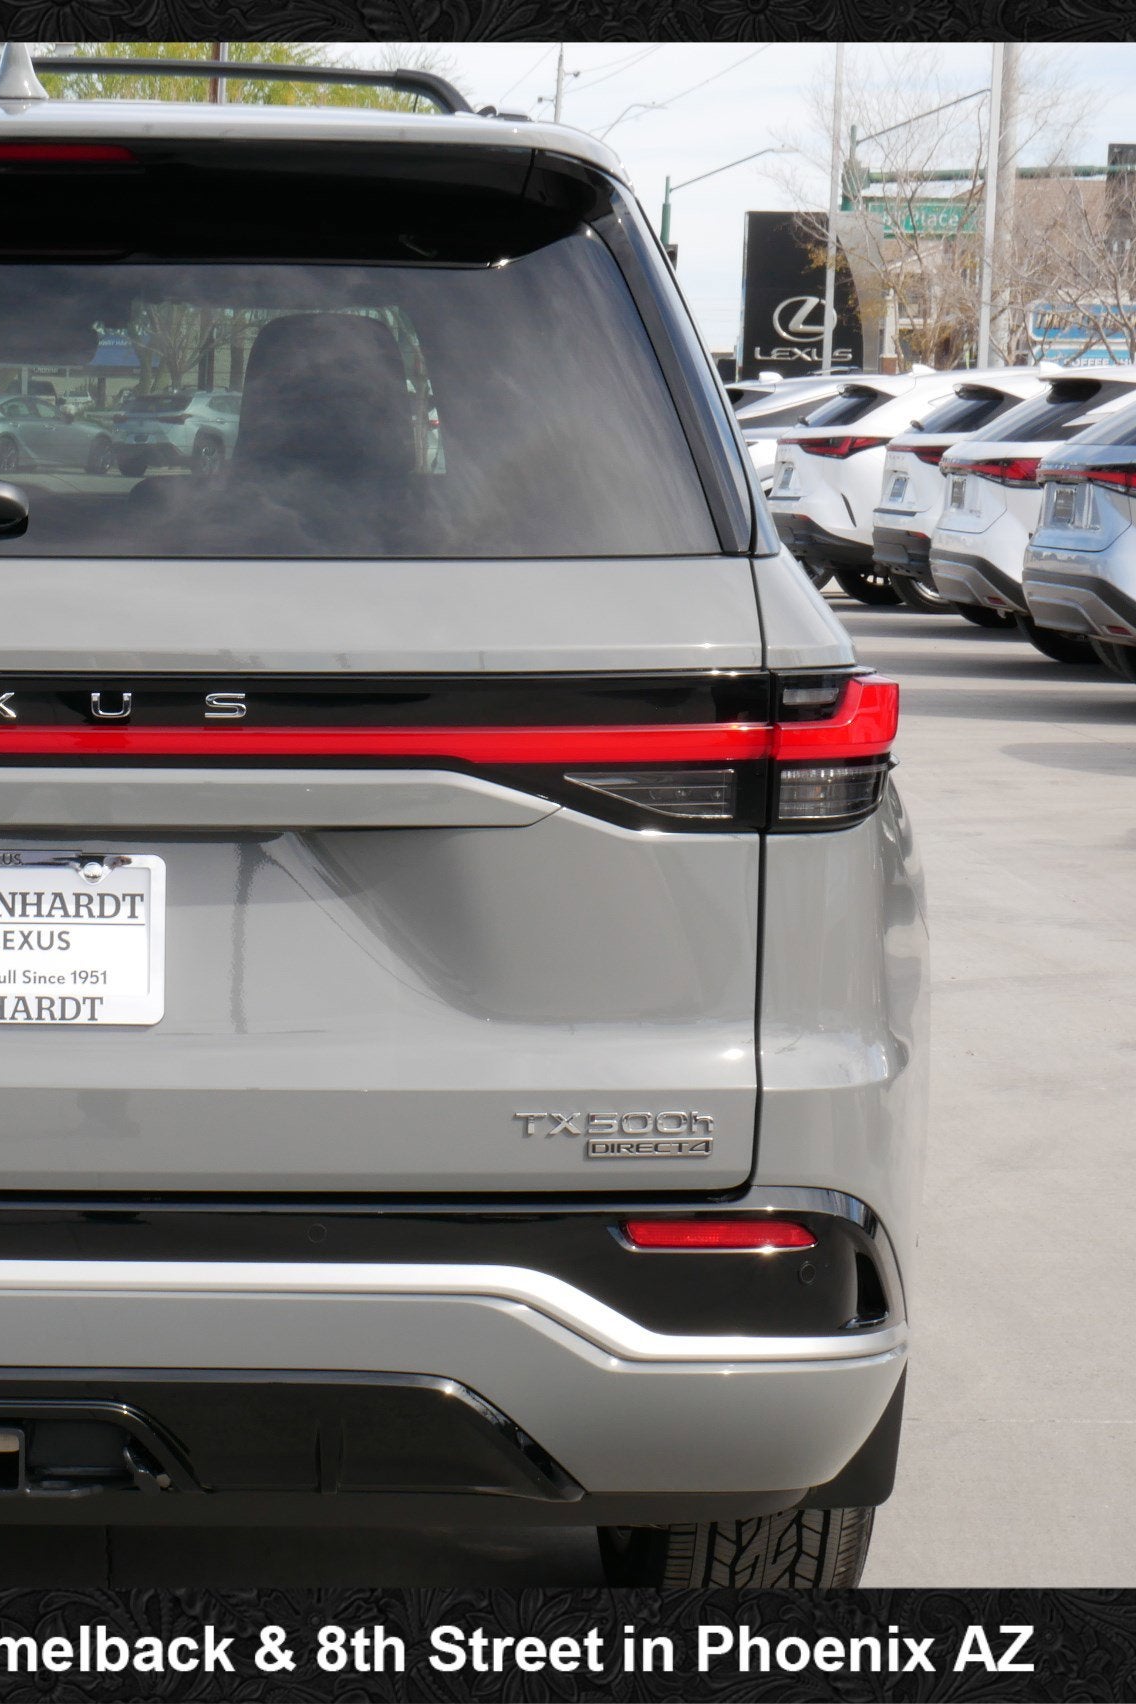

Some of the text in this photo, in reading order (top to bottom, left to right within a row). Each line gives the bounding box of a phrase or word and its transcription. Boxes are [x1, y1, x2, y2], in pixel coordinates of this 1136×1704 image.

[754, 347, 853, 362] LEXUS
[22, 970, 65, 985] Since
[71, 970, 108, 985] 1951
[591, 1140, 710, 1154] DIRECT4
